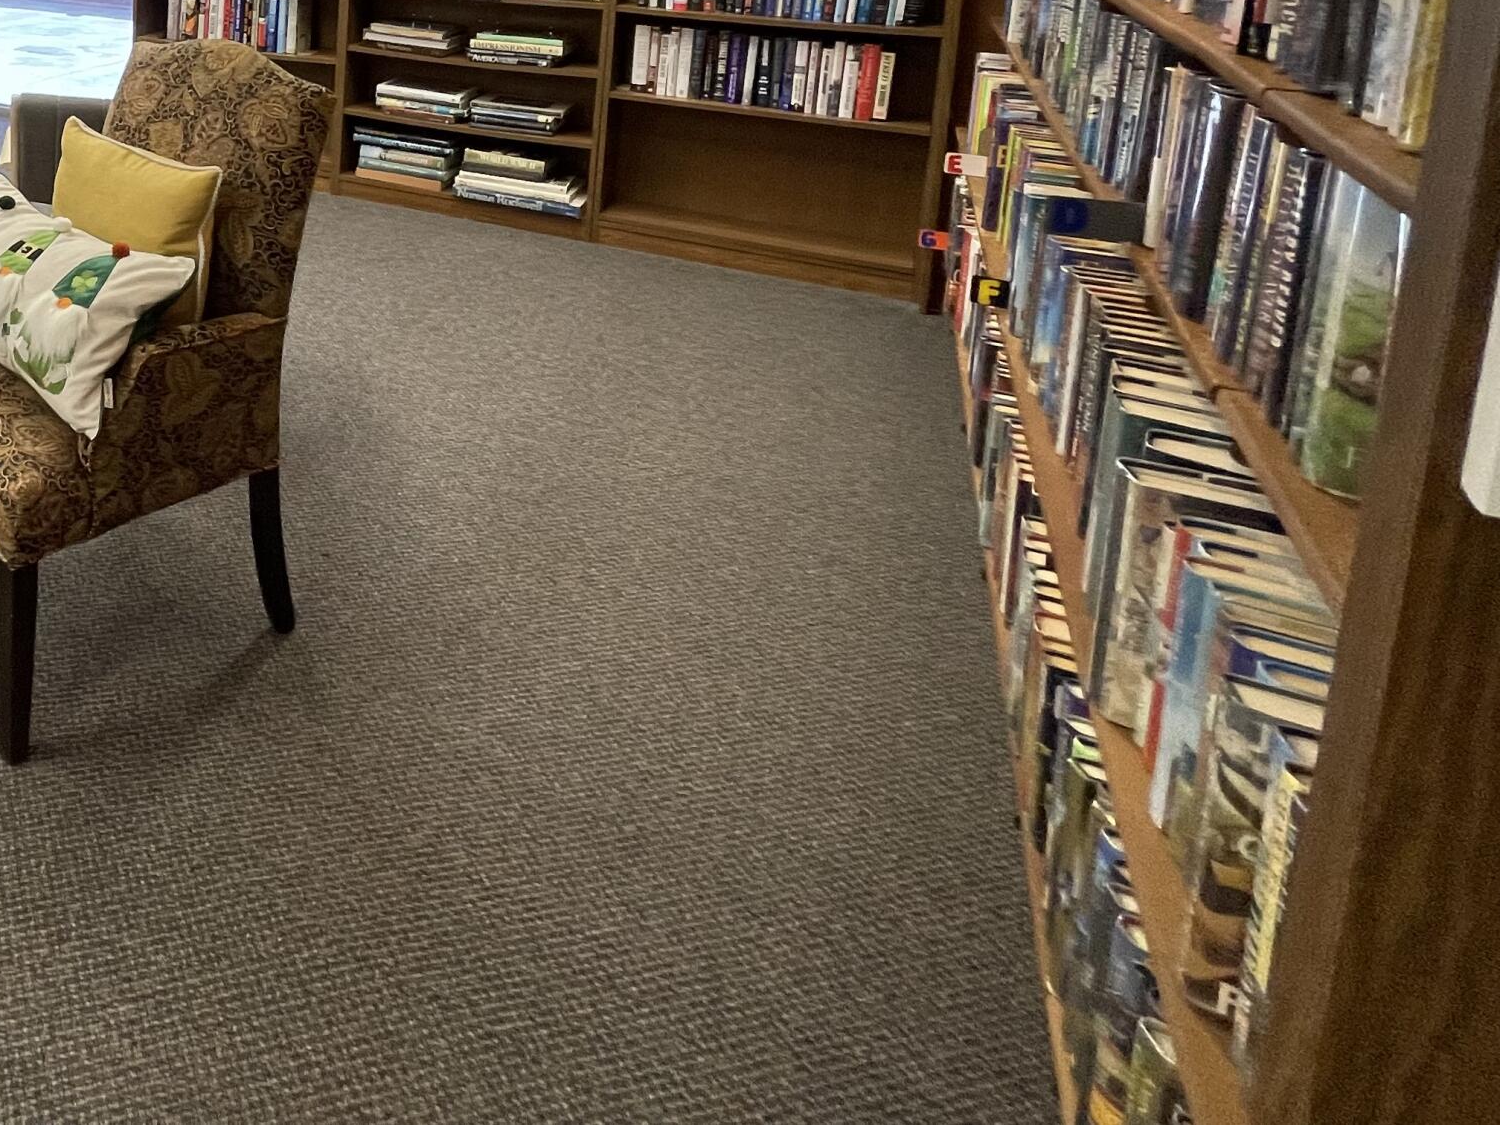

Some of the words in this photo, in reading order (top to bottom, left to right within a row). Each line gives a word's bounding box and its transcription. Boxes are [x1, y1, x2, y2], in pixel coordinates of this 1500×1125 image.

[473, 40, 541, 54] IMPRESSIONISM
[947, 155, 963, 175] E
[921, 231, 937, 247] G
[977, 279, 1000, 305] F
